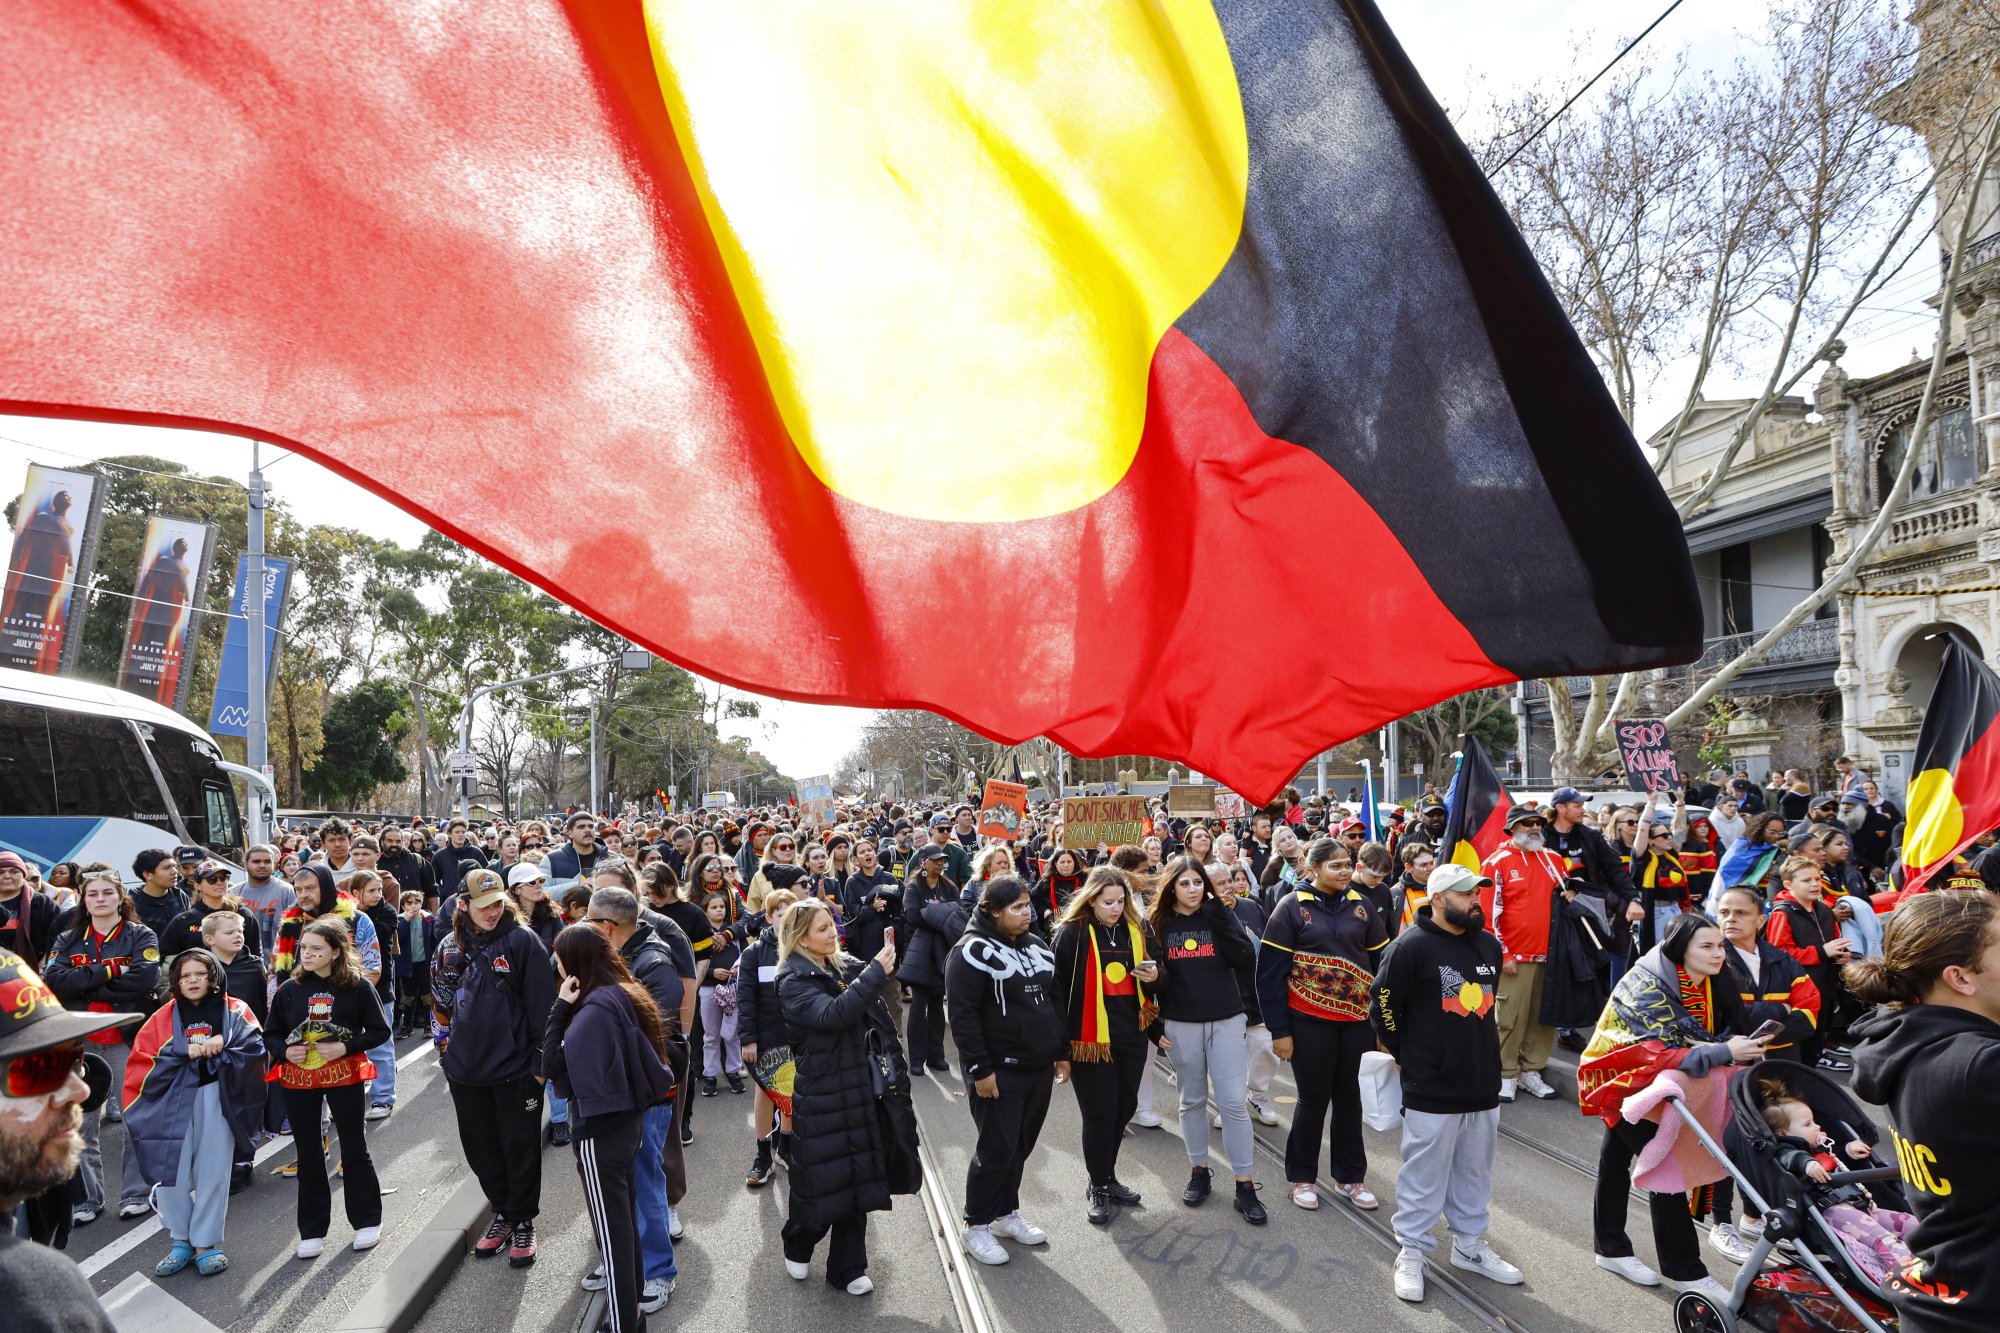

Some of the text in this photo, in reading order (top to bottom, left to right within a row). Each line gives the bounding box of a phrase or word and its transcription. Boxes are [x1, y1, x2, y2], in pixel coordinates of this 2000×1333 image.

[3, 616, 60, 632] SUPERMAN
[30, 633, 58, 642] IMAX
[13, 639, 44, 650] JULY 10
[132, 644, 179, 657] SUPERMAN
[140, 663, 165, 673] JULY 10
[154, 658, 177, 666] IMAX
[1620, 723, 1665, 749] STOP
[1643, 771, 1670, 791] US
[137, 812, 169, 821] Marcopolo
[1102, 801, 1127, 822] SING
[1127, 799, 1144, 821] ME
[1068, 821, 1143, 844] YOUR ANTHEM
